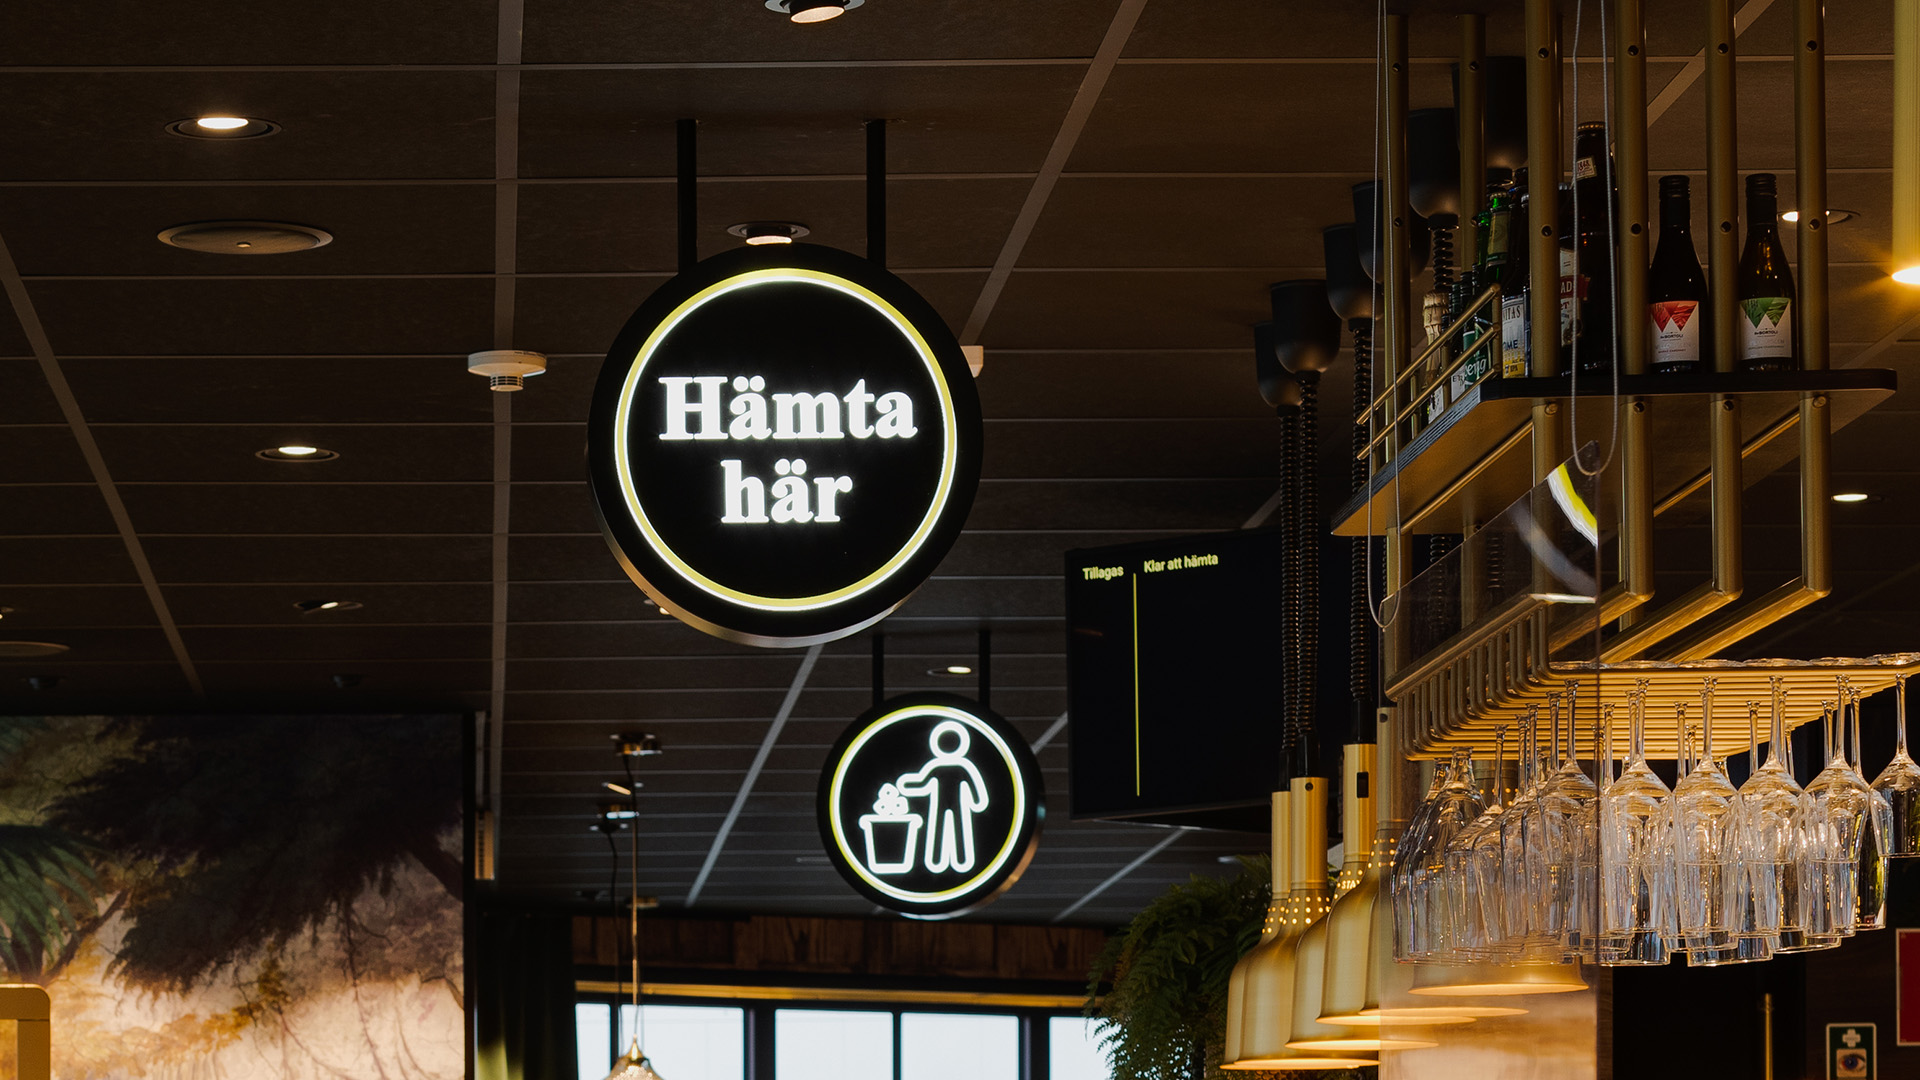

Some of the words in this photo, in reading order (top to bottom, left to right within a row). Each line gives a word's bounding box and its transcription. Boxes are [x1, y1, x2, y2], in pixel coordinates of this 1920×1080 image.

[658, 375, 918, 440] Hämta
[721, 458, 853, 524] här
[1082, 566, 1124, 581] Tillagas
[1144, 559, 1166, 573] Klar
[1167, 557, 1182, 570] att
[1184, 554, 1219, 568] hämta
